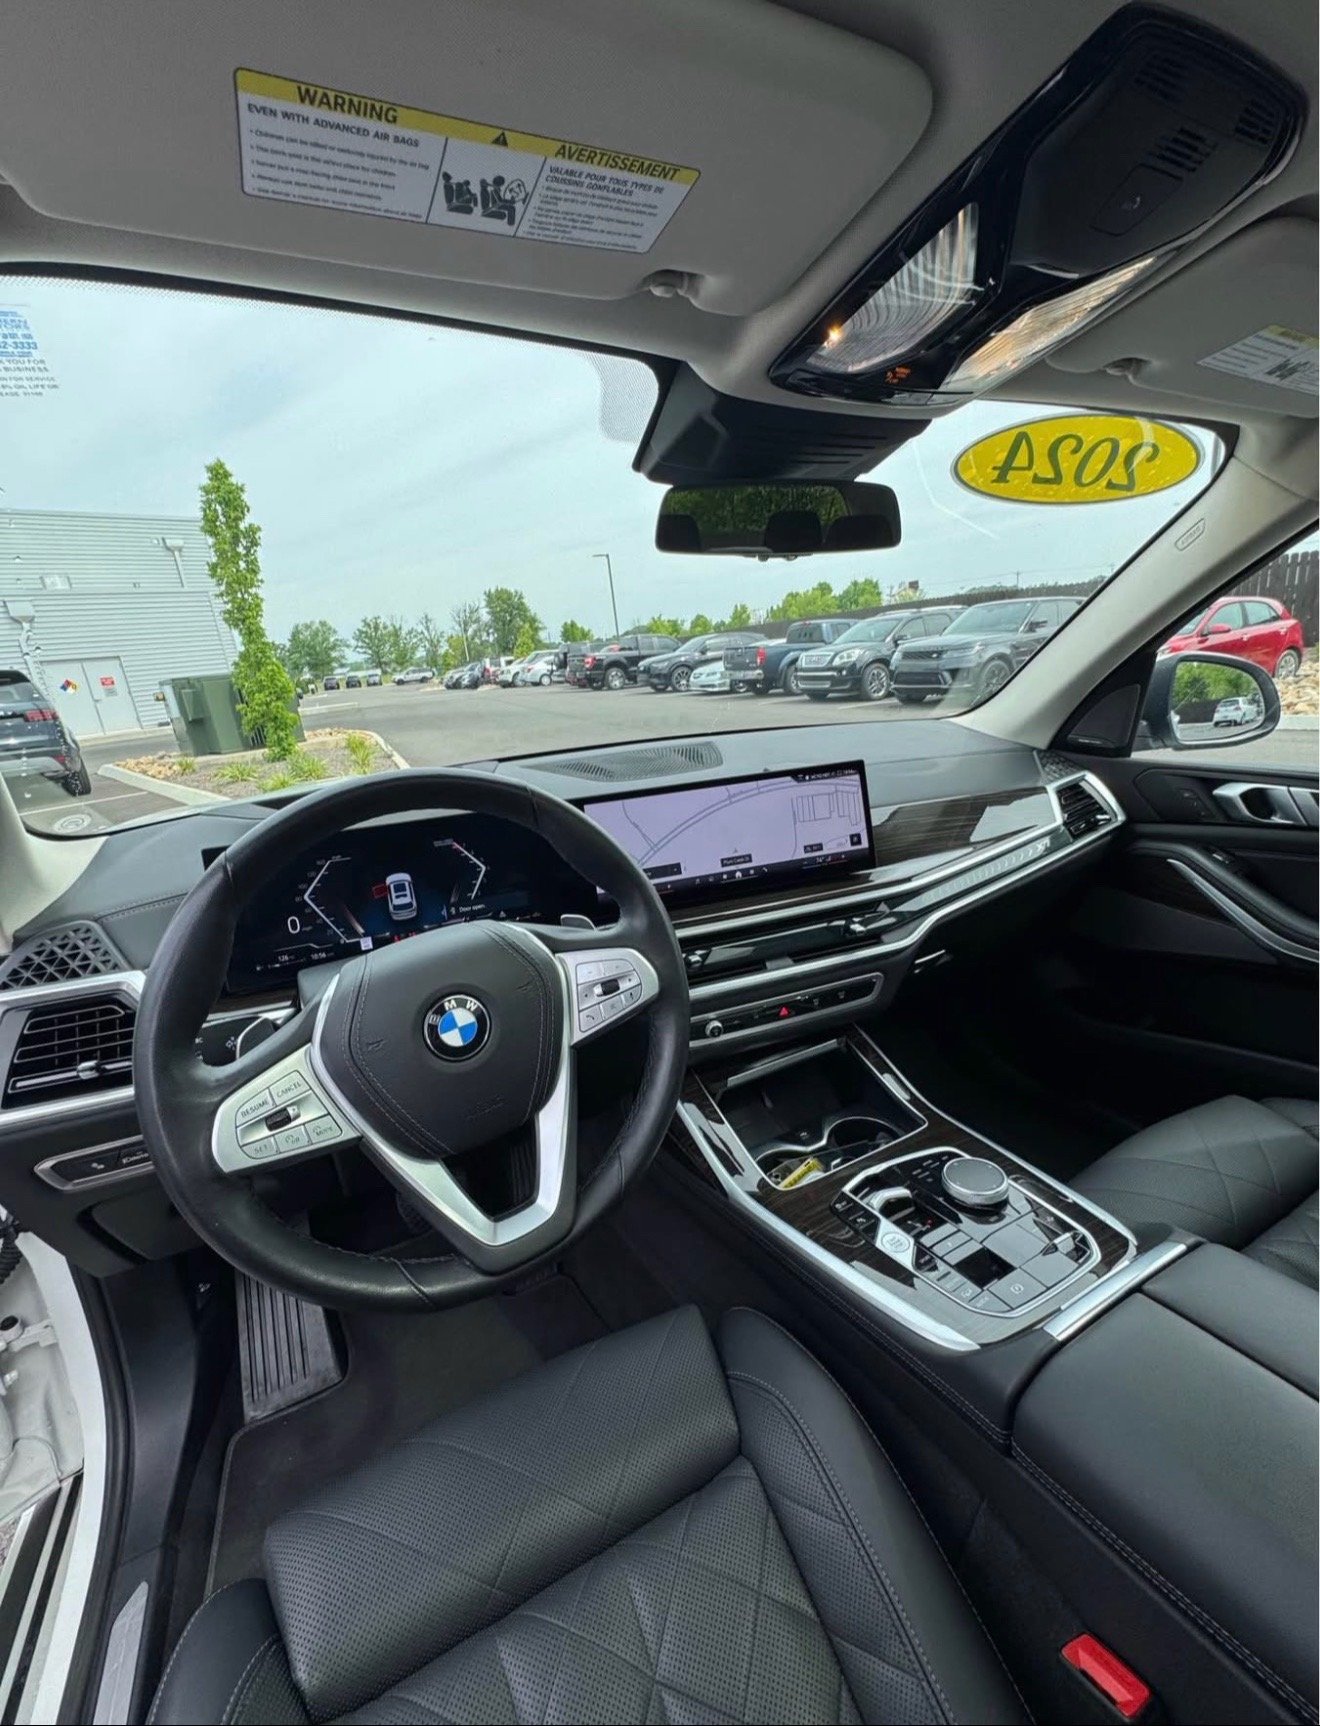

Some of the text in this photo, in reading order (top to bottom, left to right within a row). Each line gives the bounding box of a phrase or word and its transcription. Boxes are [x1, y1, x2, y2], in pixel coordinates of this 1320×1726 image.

[296, 85, 399, 124] WARNING
[247, 103, 419, 148] EVEN WITH ADVANCED AIR BAGS
[554, 144, 681, 181] AVERTISSEMENT
[550, 165, 583, 179] VALABLE
[585, 172, 607, 182] POUR
[609, 176, 629, 187] TOUS
[631, 181, 653, 192] TYPES
[287, 915, 300, 934] 0
[428, 999, 478, 1026] BMW
[276, 1081, 302, 1098] CANCEL
[240, 1098, 270, 1119] RESUME
